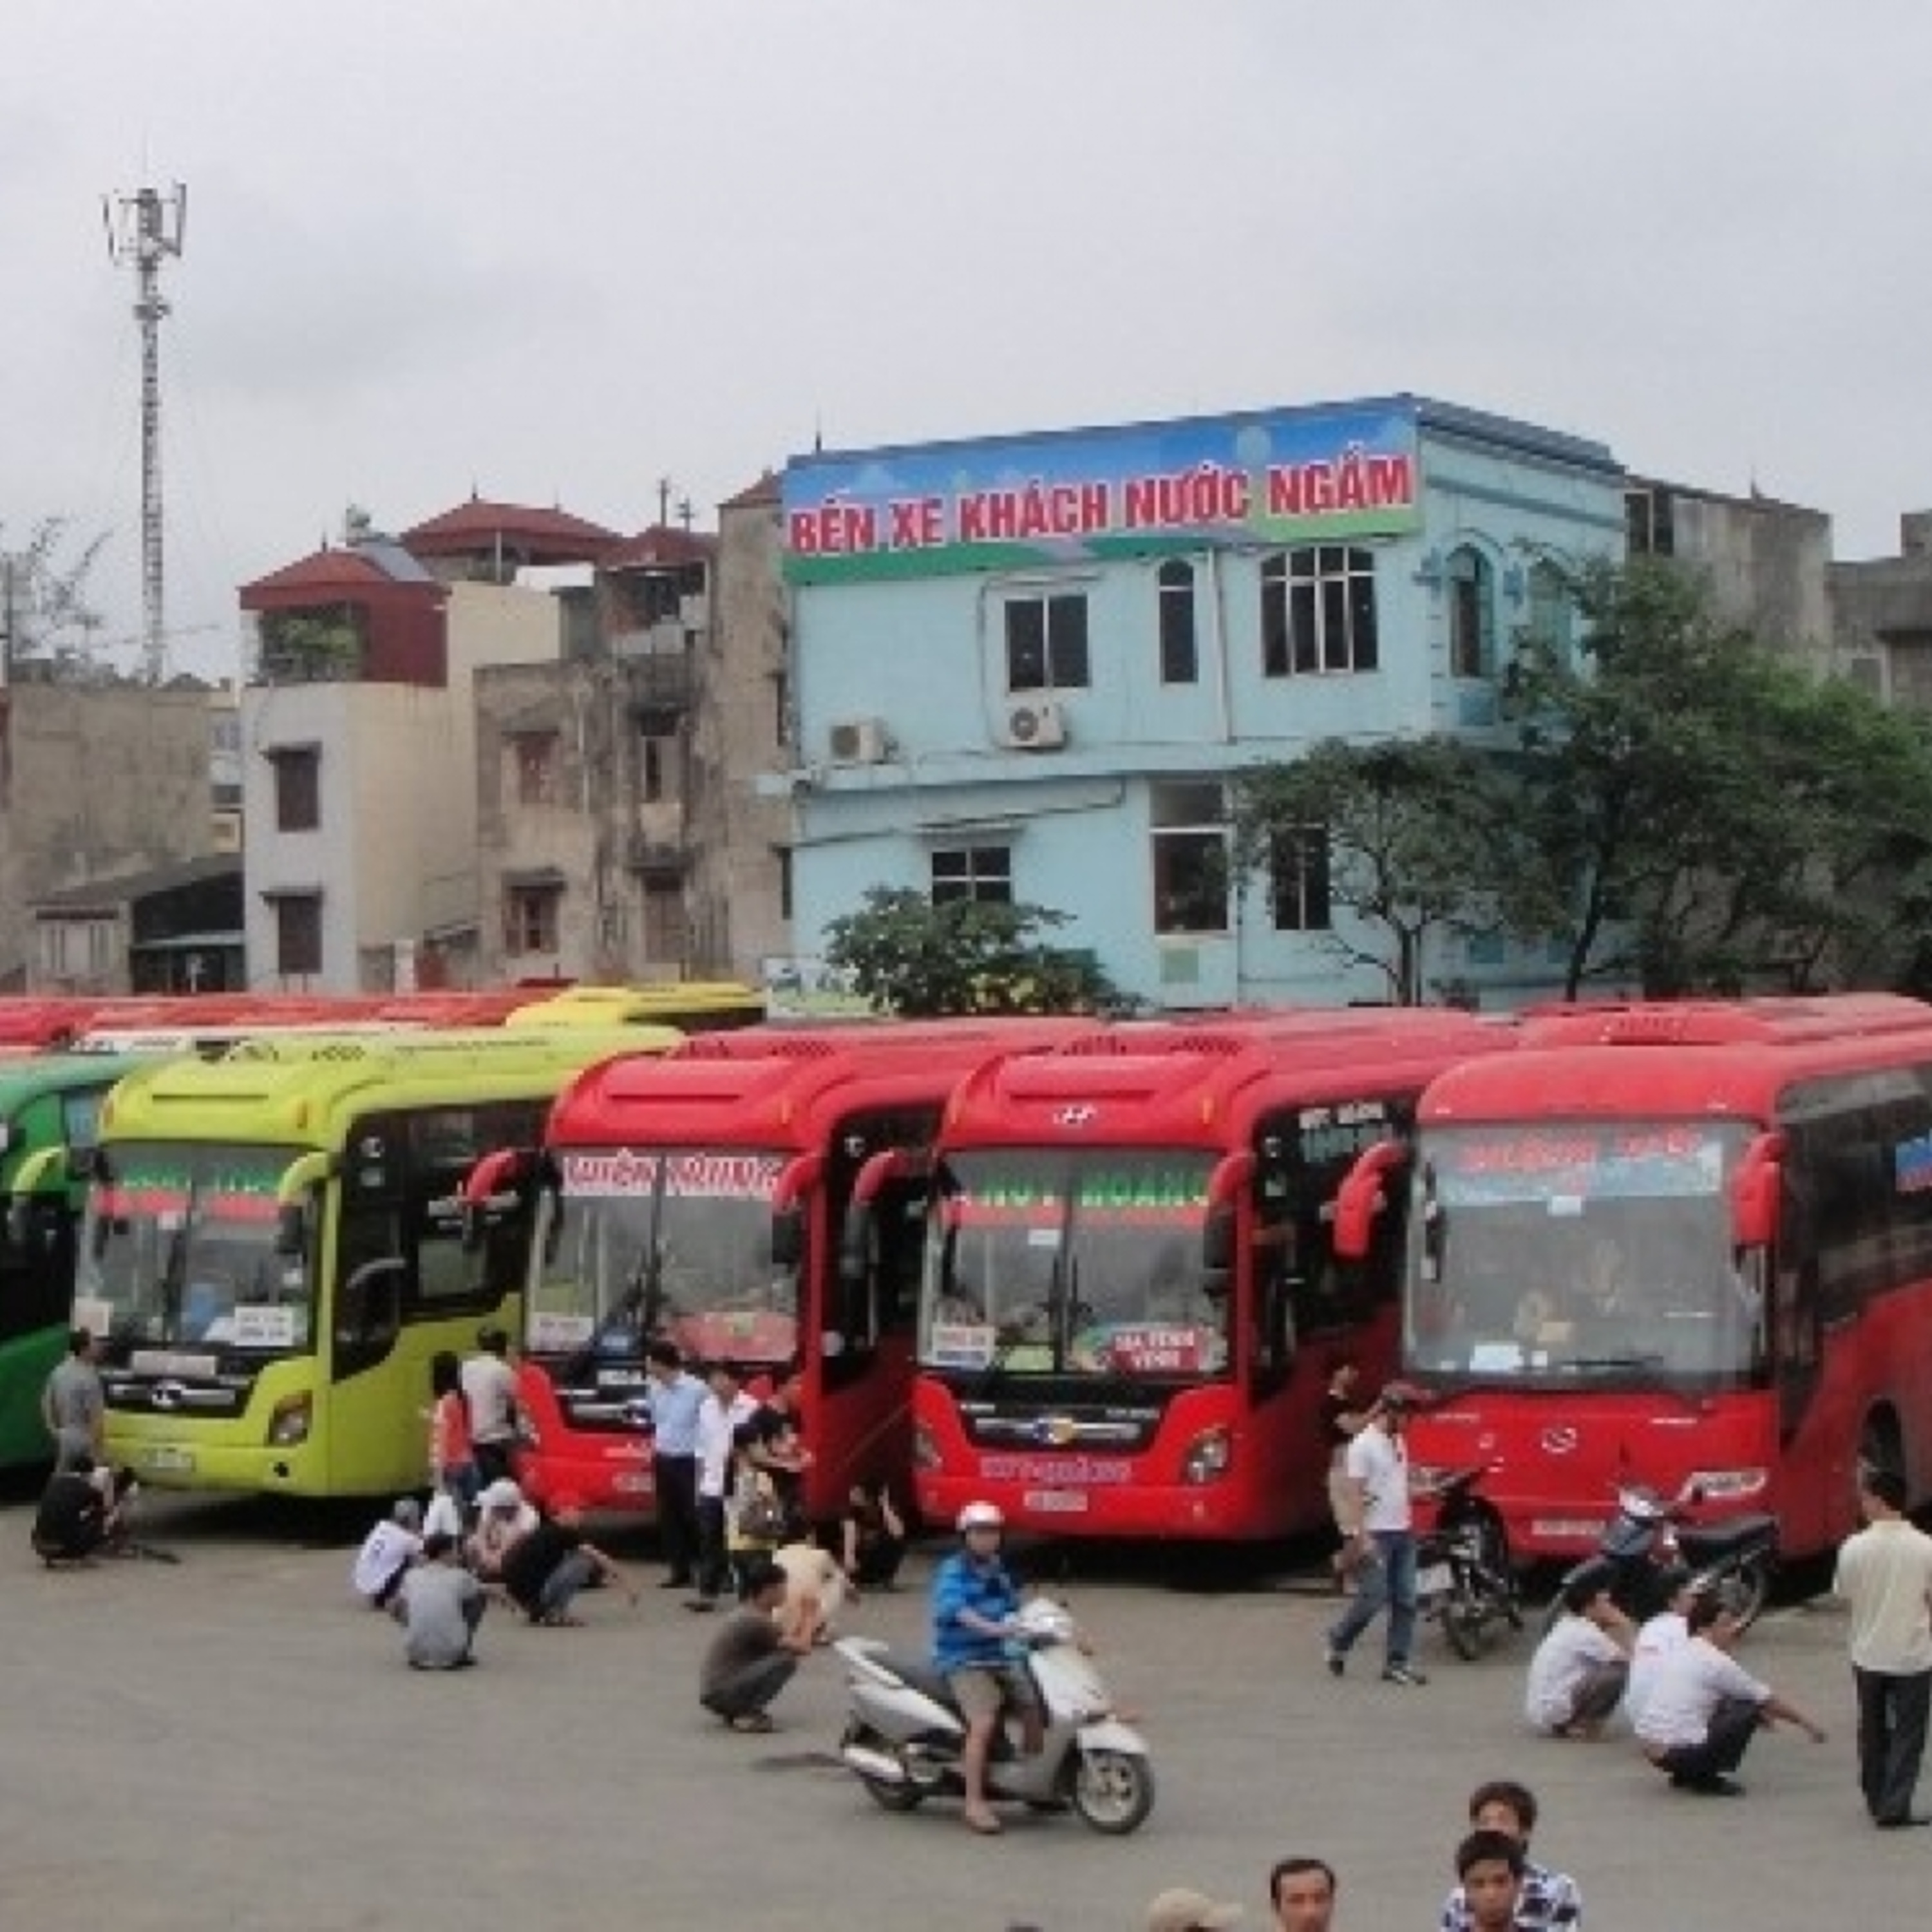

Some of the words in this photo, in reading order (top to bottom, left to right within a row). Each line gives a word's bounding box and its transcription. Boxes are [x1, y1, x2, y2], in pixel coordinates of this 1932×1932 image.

[790, 489, 877, 554] BẾN
[889, 498, 945, 551] XE
[958, 475, 1110, 542] KHÁCH
[1124, 459, 1251, 529] NƯỚC
